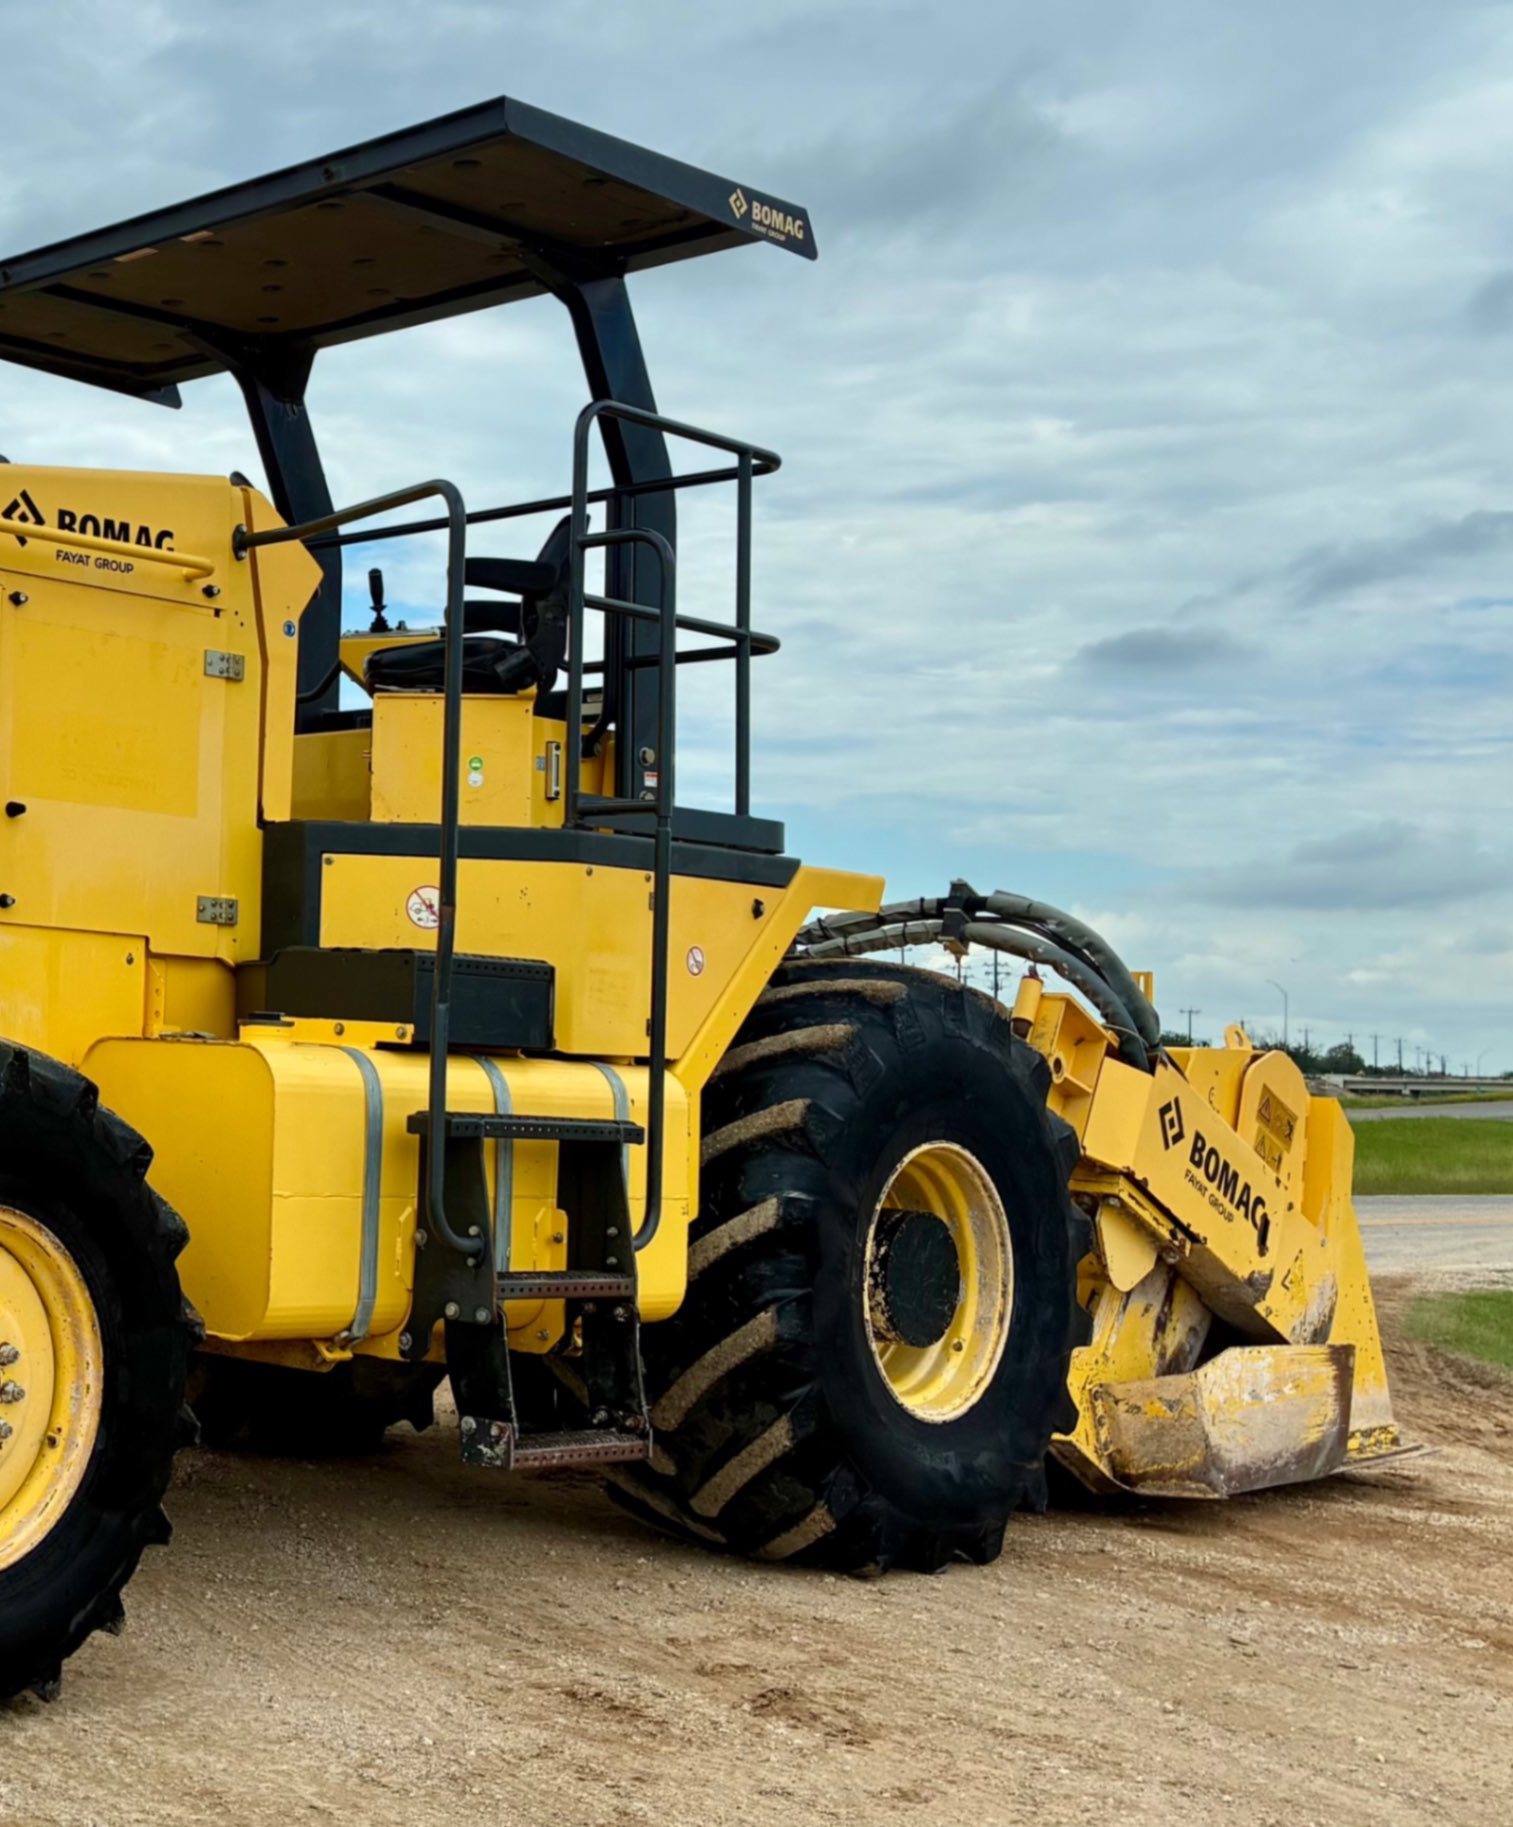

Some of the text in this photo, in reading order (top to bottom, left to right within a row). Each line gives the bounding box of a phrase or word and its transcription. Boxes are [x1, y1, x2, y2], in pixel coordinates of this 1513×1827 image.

[752, 200, 804, 240] BOMAG
[55, 549, 134, 575] FAYAT GROUP
[1184, 1168, 1235, 1223] FAYAT GROUP
